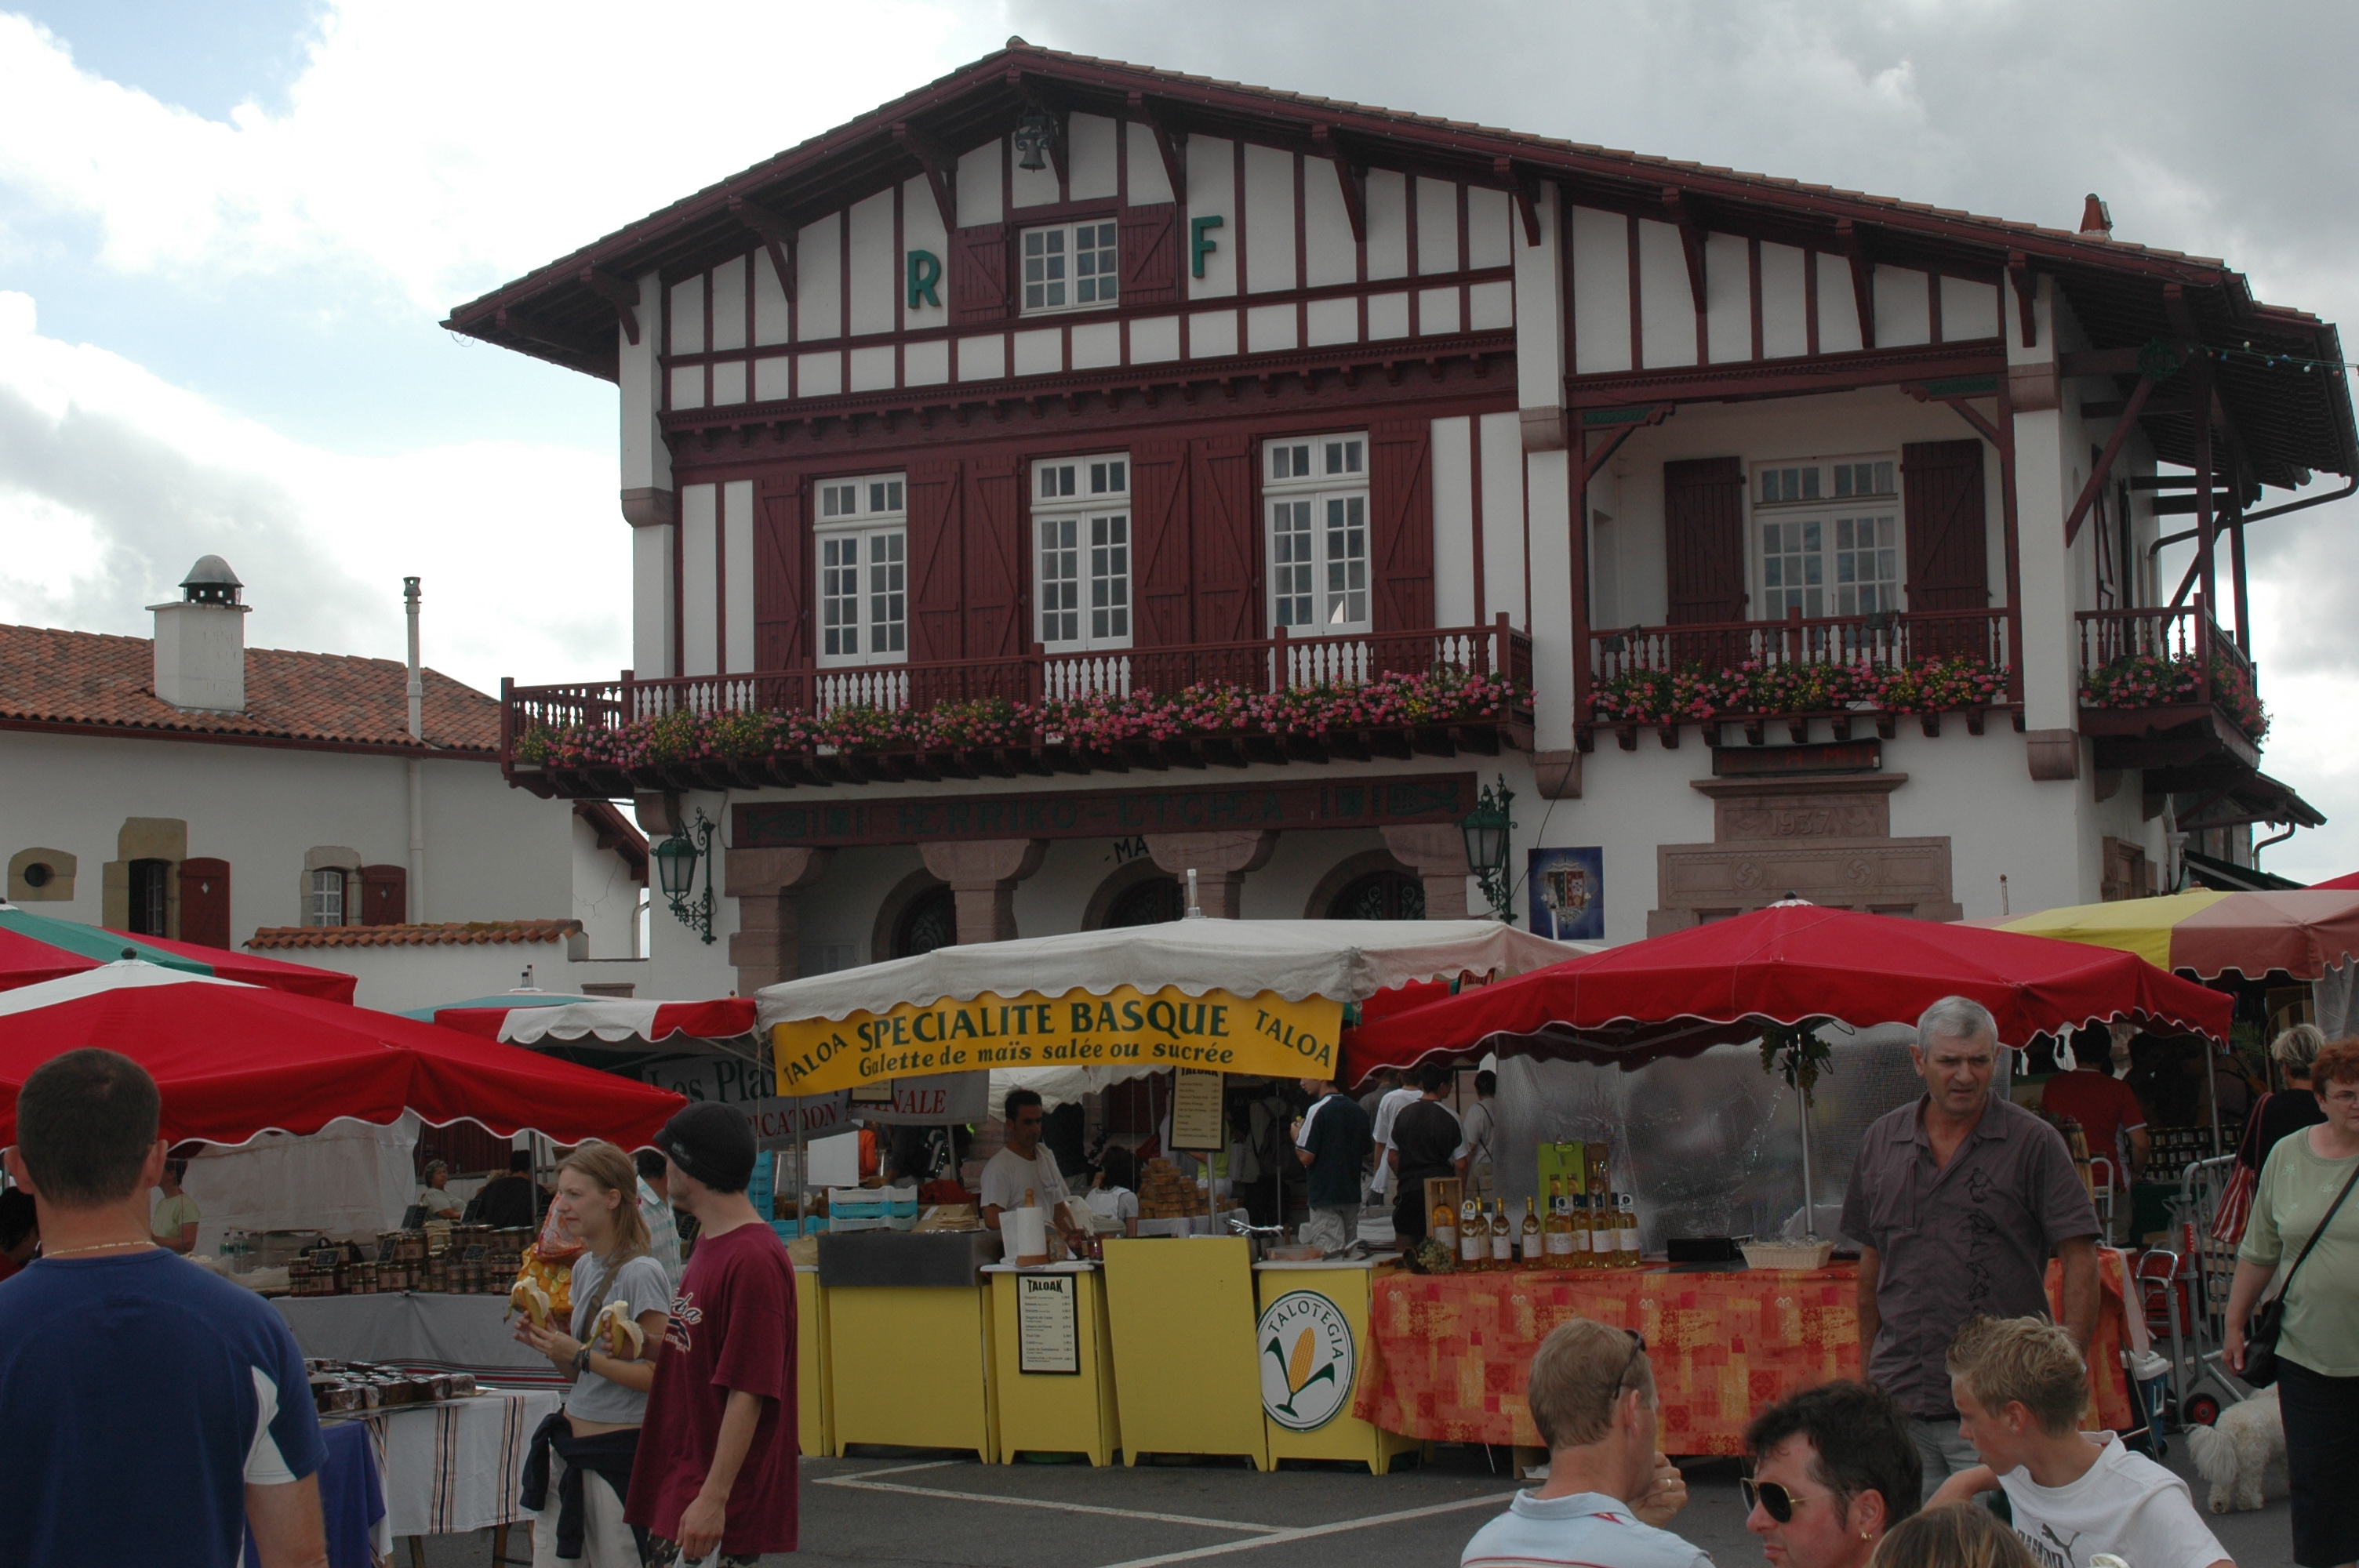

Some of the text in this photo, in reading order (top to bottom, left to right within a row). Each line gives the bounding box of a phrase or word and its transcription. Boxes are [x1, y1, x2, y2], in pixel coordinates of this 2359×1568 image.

[907, 215, 1223, 310] R F
[1771, 810, 1831, 837] 1937
[783, 1000, 1332, 1086] TALOA SPECIALITE BASQUE TALOA
[859, 1037, 1234, 1077] Galette de maïs salée ou sucrée
[1026, 1278, 1063, 1294] TALOAK
[1267, 1299, 1344, 1360] TALOTEGIA
